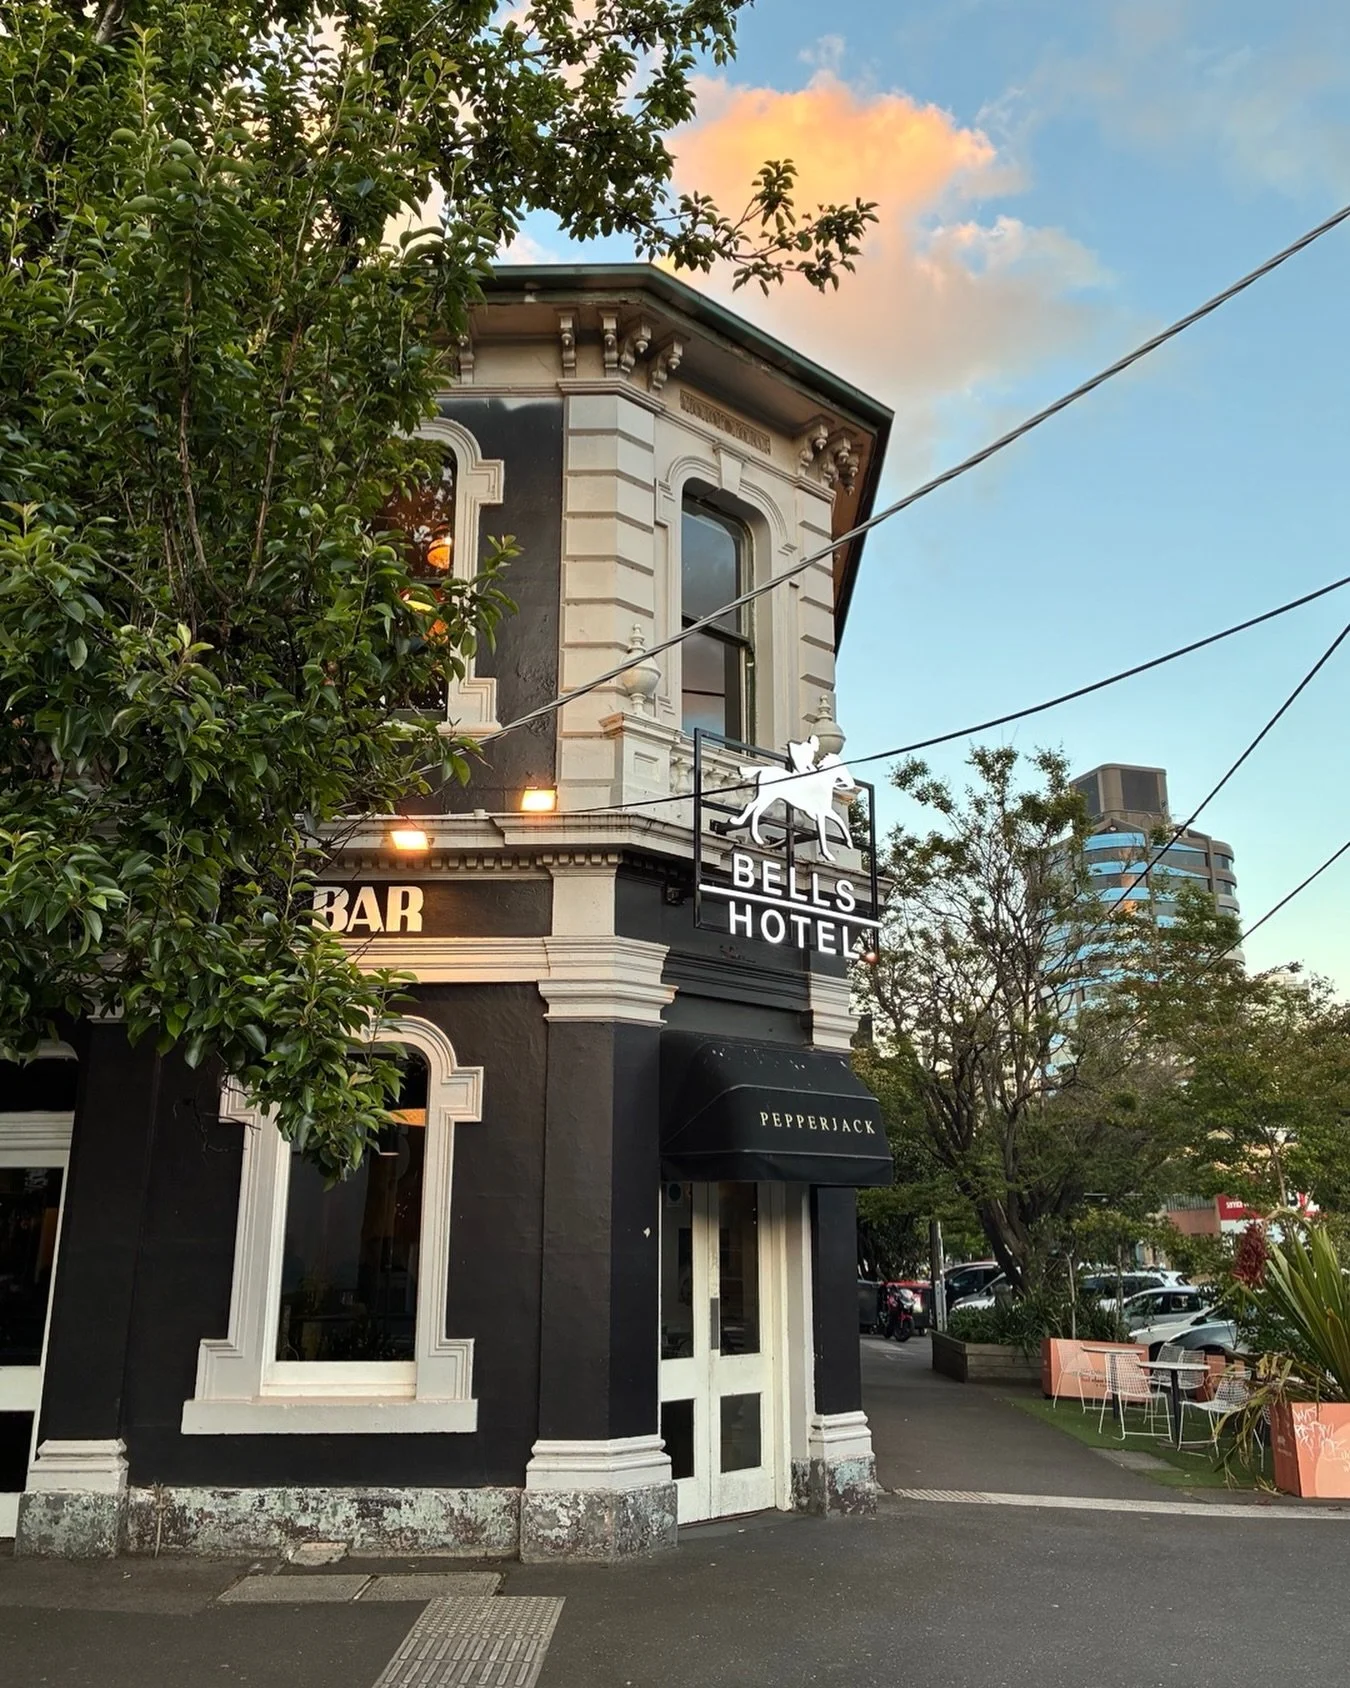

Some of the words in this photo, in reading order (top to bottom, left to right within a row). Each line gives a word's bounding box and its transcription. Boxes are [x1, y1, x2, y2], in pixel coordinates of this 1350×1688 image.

[732, 853, 855, 912] BELLS
[311, 886, 424, 932] BAR
[729, 901, 860, 959] HOTEL
[760, 1112, 875, 1134] PEPPERJACK
